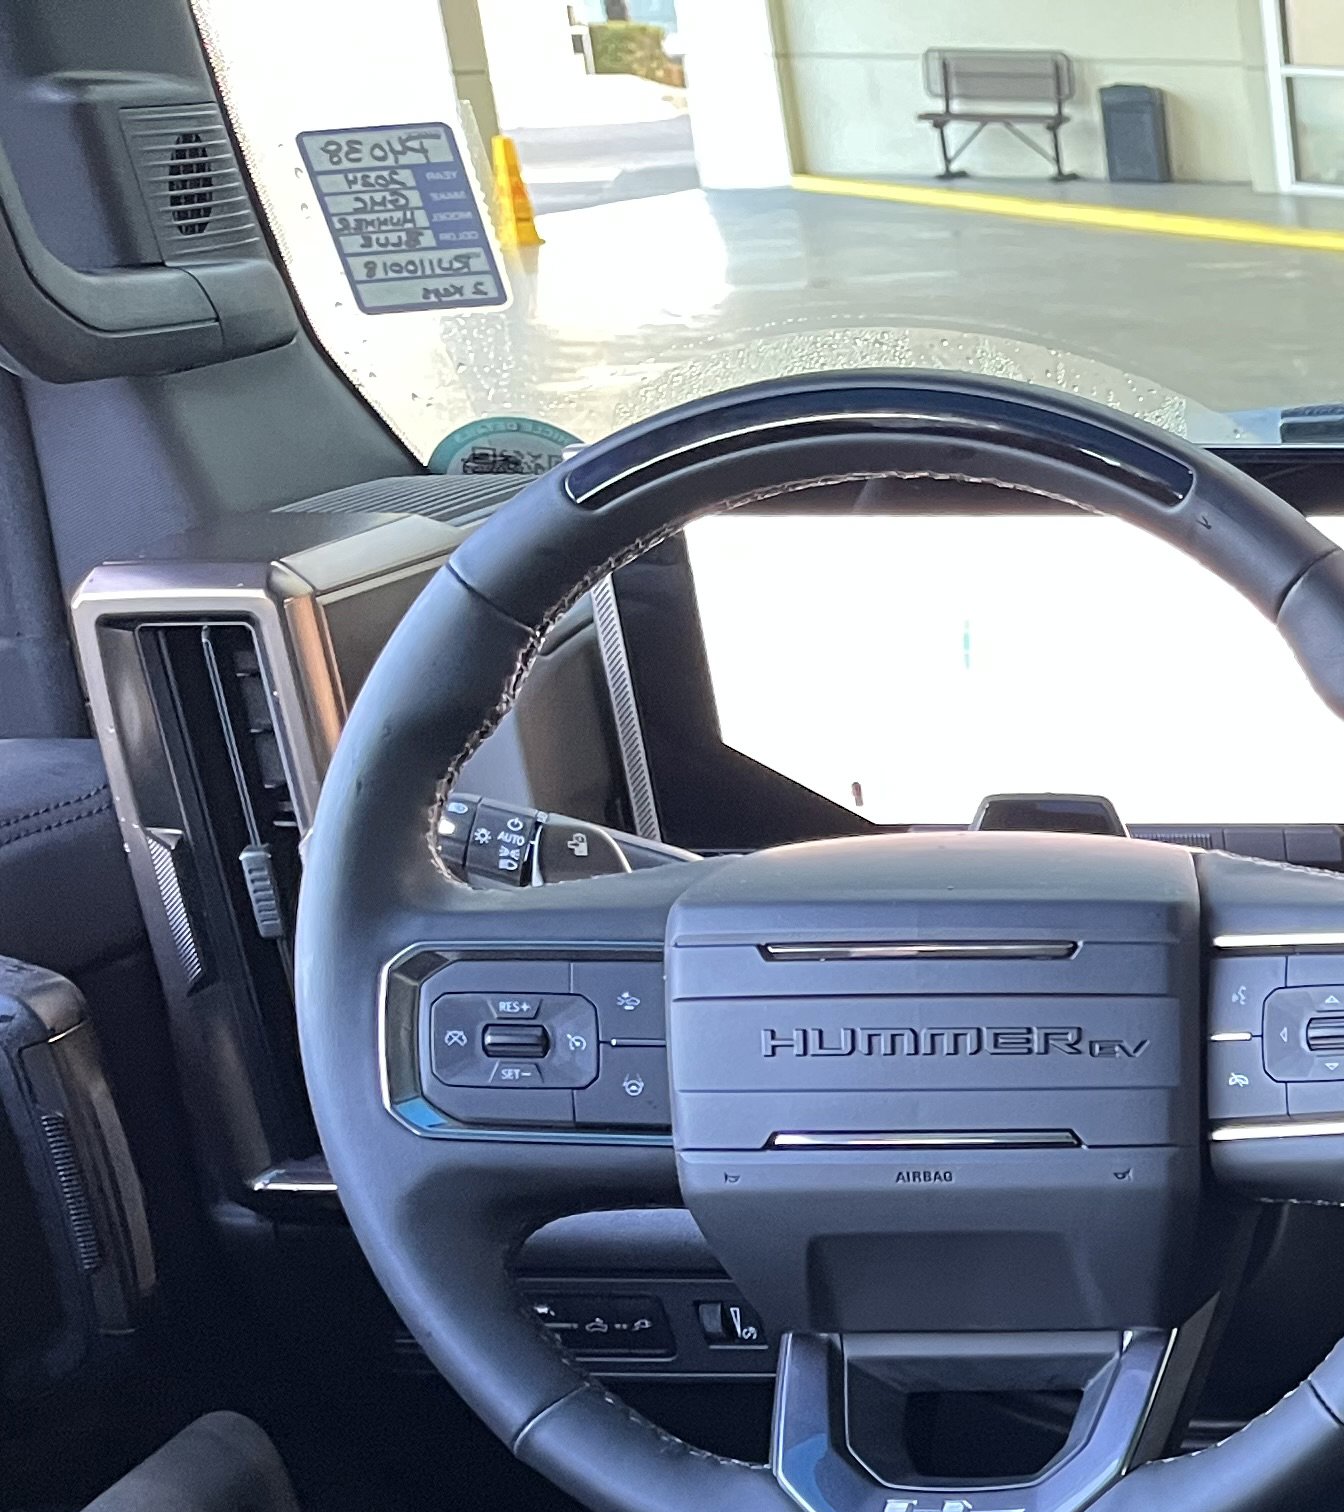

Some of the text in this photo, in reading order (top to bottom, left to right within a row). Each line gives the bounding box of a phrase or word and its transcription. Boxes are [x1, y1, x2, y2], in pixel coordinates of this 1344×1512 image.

[497, 832, 526, 847] AUTO
[761, 1025, 1151, 1060] HUMMER EV
[895, 1169, 954, 1186] AIRBAG
